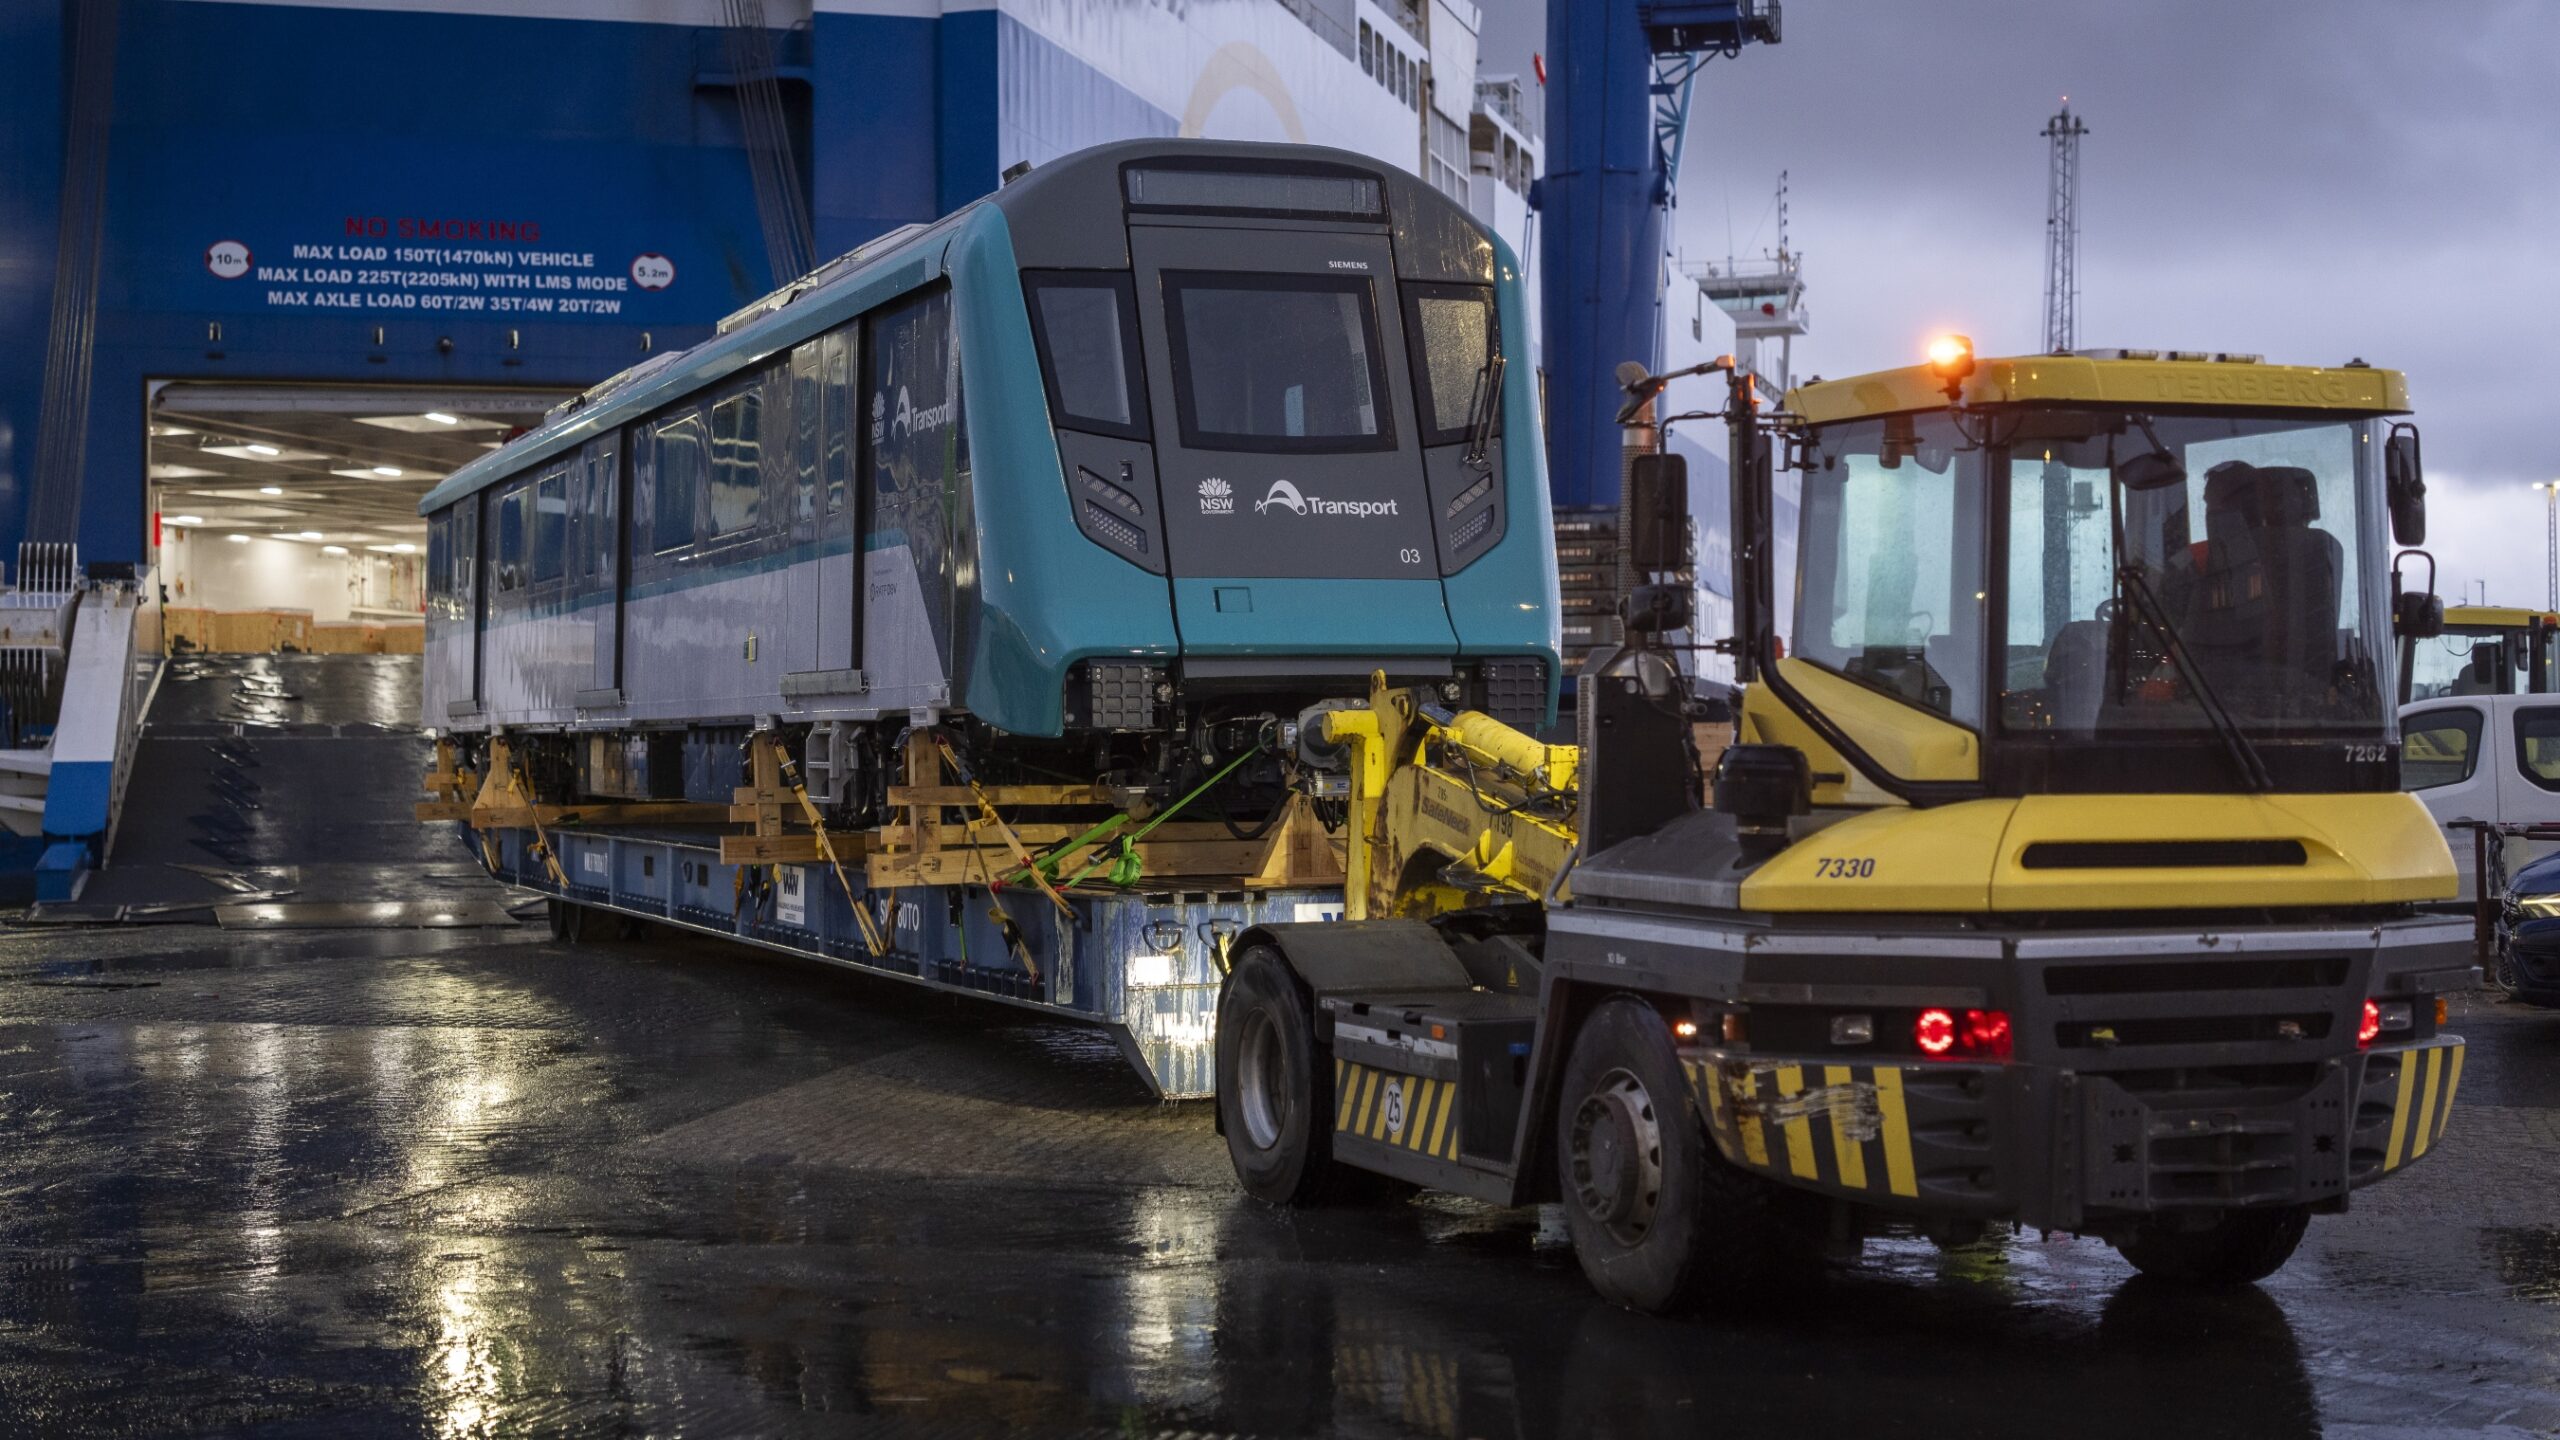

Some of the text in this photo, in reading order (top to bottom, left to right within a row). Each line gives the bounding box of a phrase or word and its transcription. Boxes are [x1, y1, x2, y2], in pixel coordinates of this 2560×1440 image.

[345, 217, 541, 241] NO SMOKING
[293, 245, 594, 268] MAX LOAD 150T(1470kN) VEHICLE
[1328, 260, 1368, 270] SIEMENS
[258, 267, 628, 291] MAX LOAD 225T(2205kN) WITH LMS MODE
[267, 291, 621, 314] MAX AXLE LOAD 60T/2W 35T/4W 20T/2W
[2146, 373, 2349, 403] TERBERG
[911, 397, 949, 433] Transport
[871, 420, 885, 440] NSW
[1200, 498, 1234, 510] NSW
[1306, 497, 1398, 518] Transport
[1400, 548, 1421, 564] 03
[2344, 745, 2387, 762] 7262
[1421, 796, 1471, 837] SafeNeck
[1815, 858, 1876, 878] 7330
[1388, 1091, 1400, 1124] 25
